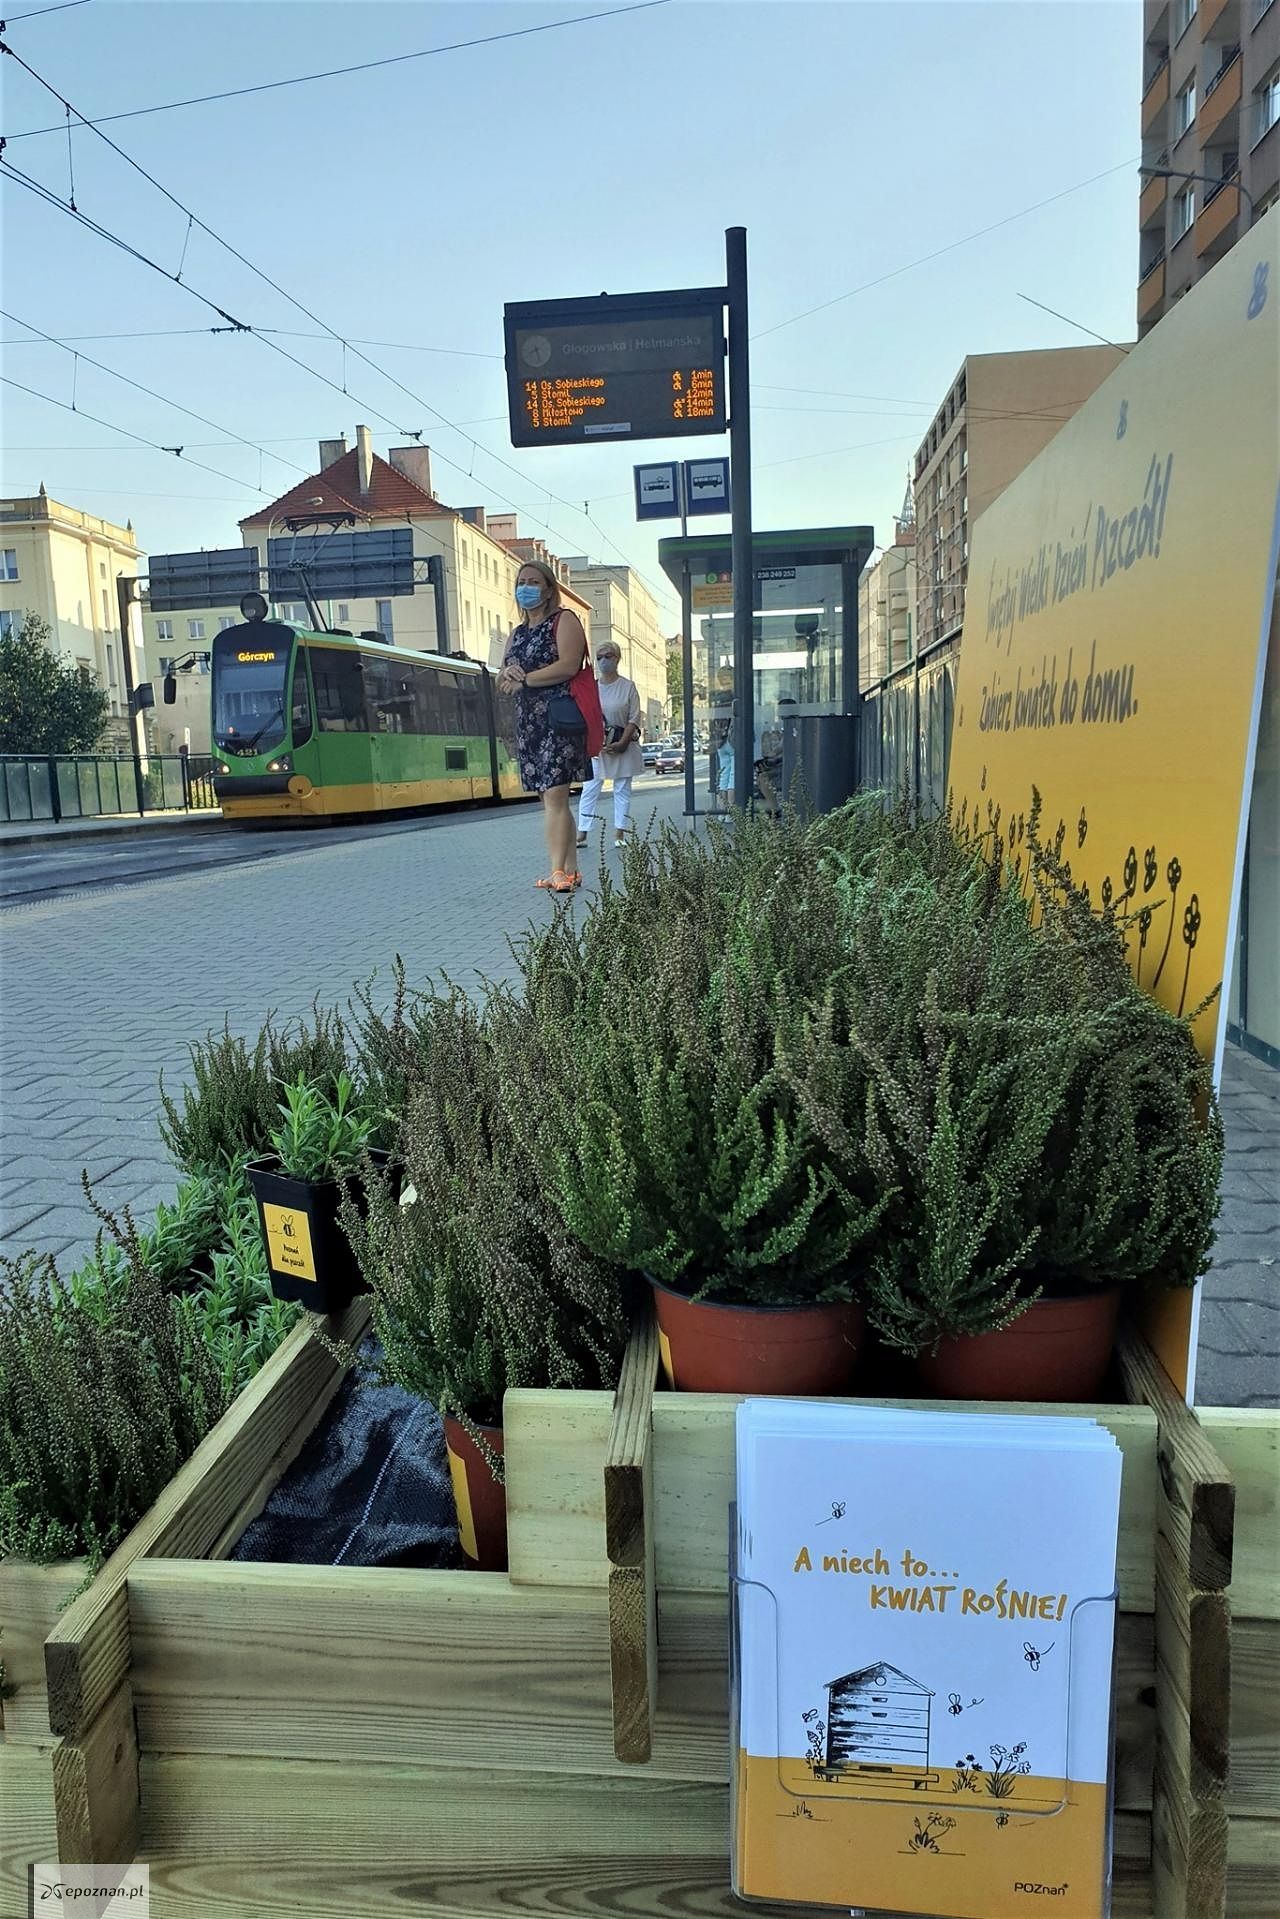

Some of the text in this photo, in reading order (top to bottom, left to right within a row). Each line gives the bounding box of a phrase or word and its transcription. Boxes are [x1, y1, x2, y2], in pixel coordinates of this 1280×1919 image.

[525, 381, 537, 392] 14
[541, 380, 554, 390] Os.
[555, 378, 605, 389] Sobieskiego
[541, 389, 571, 399] Stomil
[526, 400, 538, 410] 14
[557, 396, 605, 407] Sobieskiego
[532, 418, 540, 428] 5
[543, 416, 572, 427] Stomil
[1051, 500, 1092, 608] Dzień
[1091, 452, 1173, 593] Pszczół!
[238, 652, 275, 663] Górczyn
[979, 638, 1139, 733] Zabierz kwiatek do domu.
[794, 1546, 960, 1578] A niech to...
[870, 1578, 1068, 1622] KWIAT ROŚNIE!
